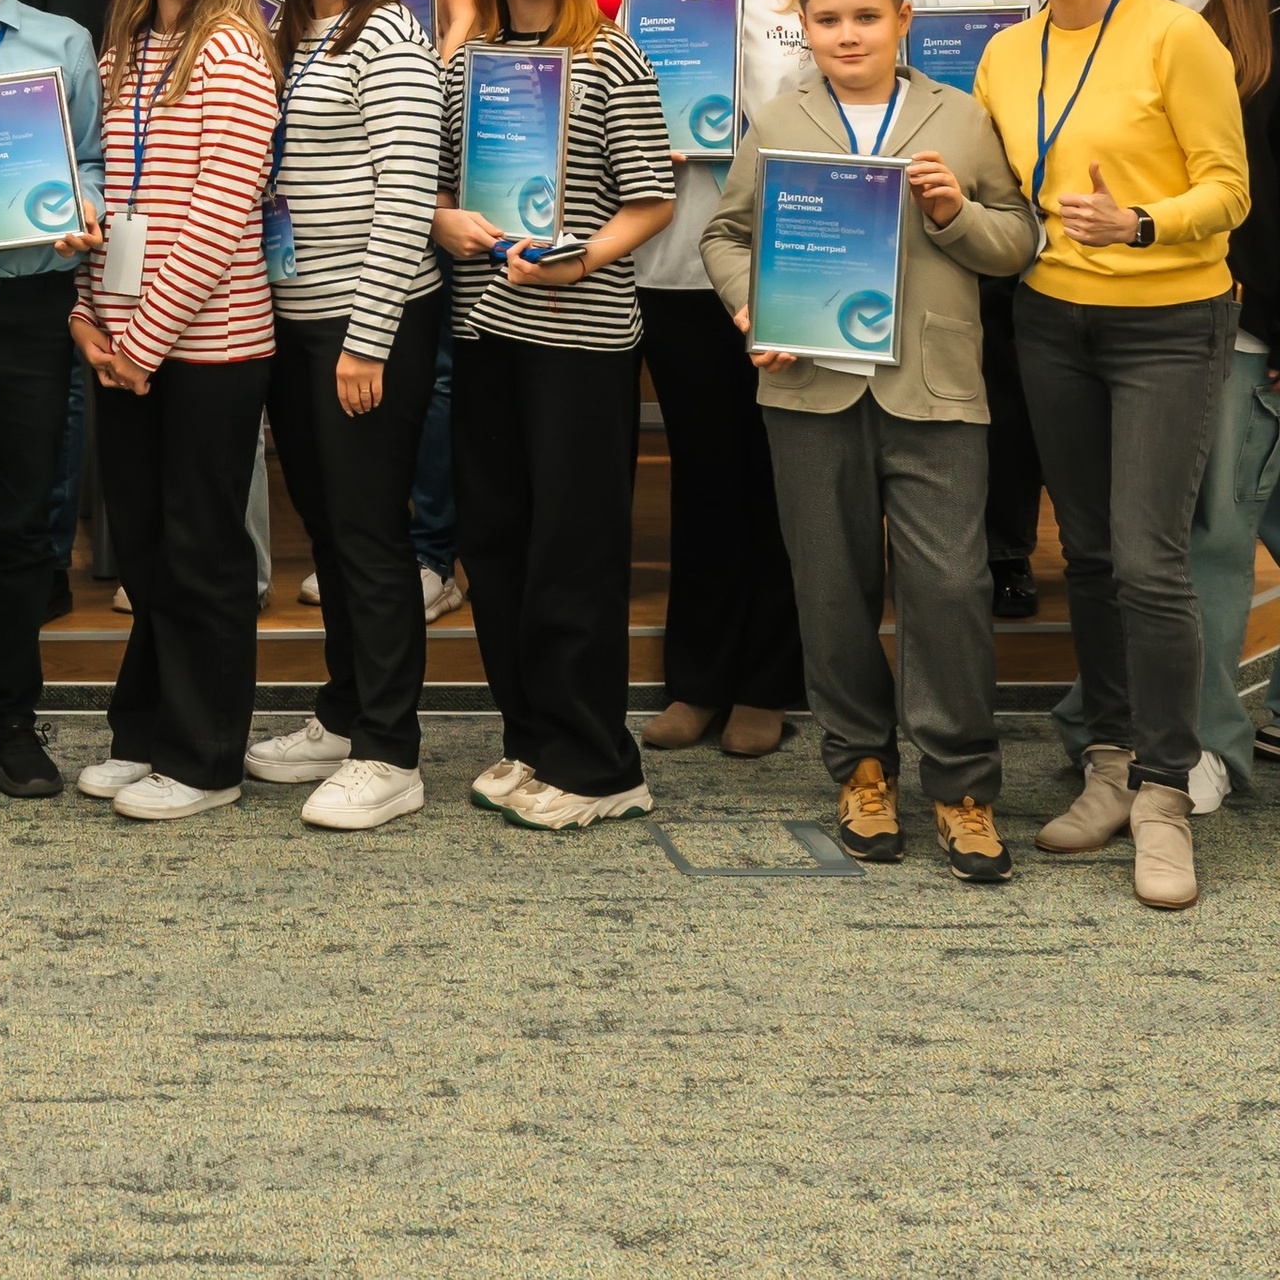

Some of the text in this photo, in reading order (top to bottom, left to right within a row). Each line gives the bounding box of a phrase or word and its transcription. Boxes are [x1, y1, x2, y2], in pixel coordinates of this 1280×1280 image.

[640, 17, 675, 26] Диплом
[923, 38, 961, 47] Диплом
[479, 84, 510, 94] Диплом
[778, 191, 823, 203] Диплом
[778, 203, 822, 212] участника
[775, 241, 846, 253] Бунтов Дмитрий
